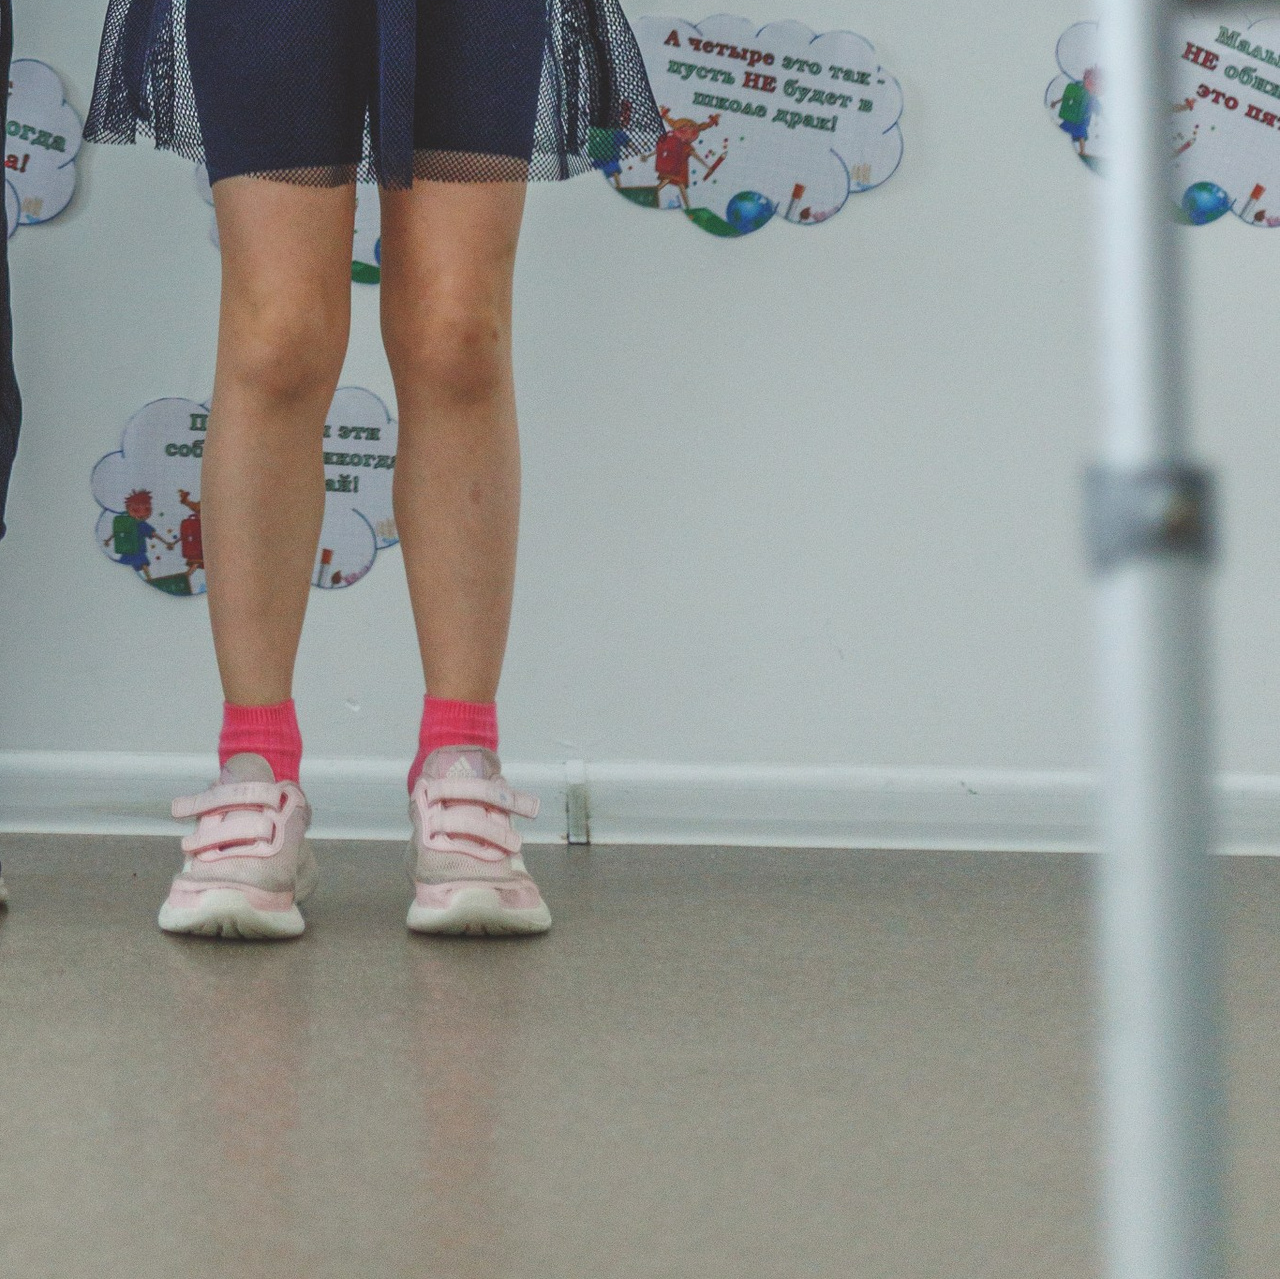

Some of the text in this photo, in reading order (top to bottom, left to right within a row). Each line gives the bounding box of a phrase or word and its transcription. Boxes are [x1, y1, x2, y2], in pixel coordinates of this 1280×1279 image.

[663, 29, 872, 86] А четыре это так
[1181, 41, 1219, 72] НЕ
[667, 60, 874, 113] пусть НЕ будет в
[1196, 83, 1280, 131] это пя
[692, 91, 839, 133] школе драк!
